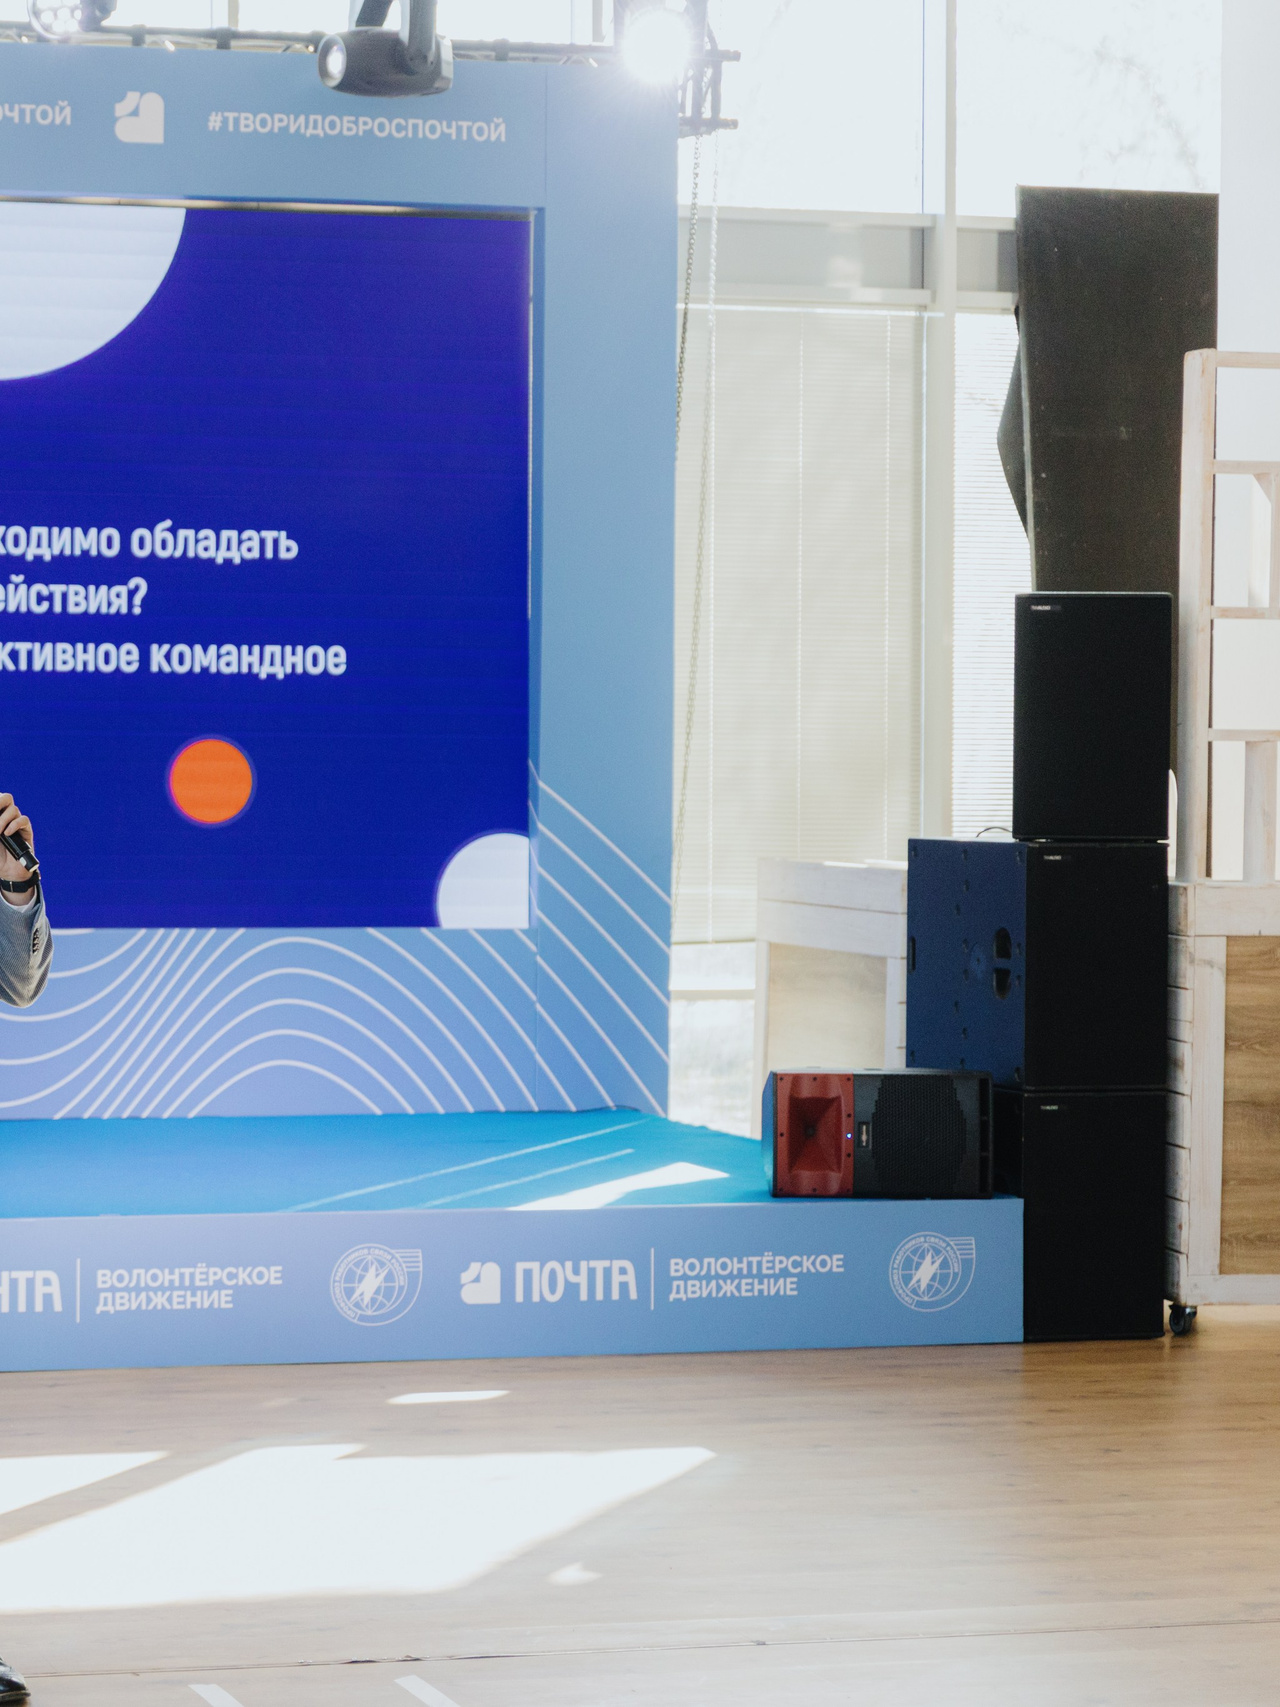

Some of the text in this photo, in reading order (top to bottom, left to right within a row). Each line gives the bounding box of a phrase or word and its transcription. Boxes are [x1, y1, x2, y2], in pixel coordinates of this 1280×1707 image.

[208, 111, 507, 143] #ТВОРИДОБРОСПОЧТОЙ
[130, 519, 299, 564] обладать
[150, 643, 347, 679] командное
[96, 1262, 283, 1289] ВОЛОНТЁРСКОЕ
[669, 1252, 845, 1278] ВОЛОНТЁРСКОЕ
[515, 1259, 638, 1303] ПОЧТА
[668, 1277, 798, 1302] ДВИЖЕНИЕ
[95, 1289, 234, 1315] ДВИЖЕНИЕ
